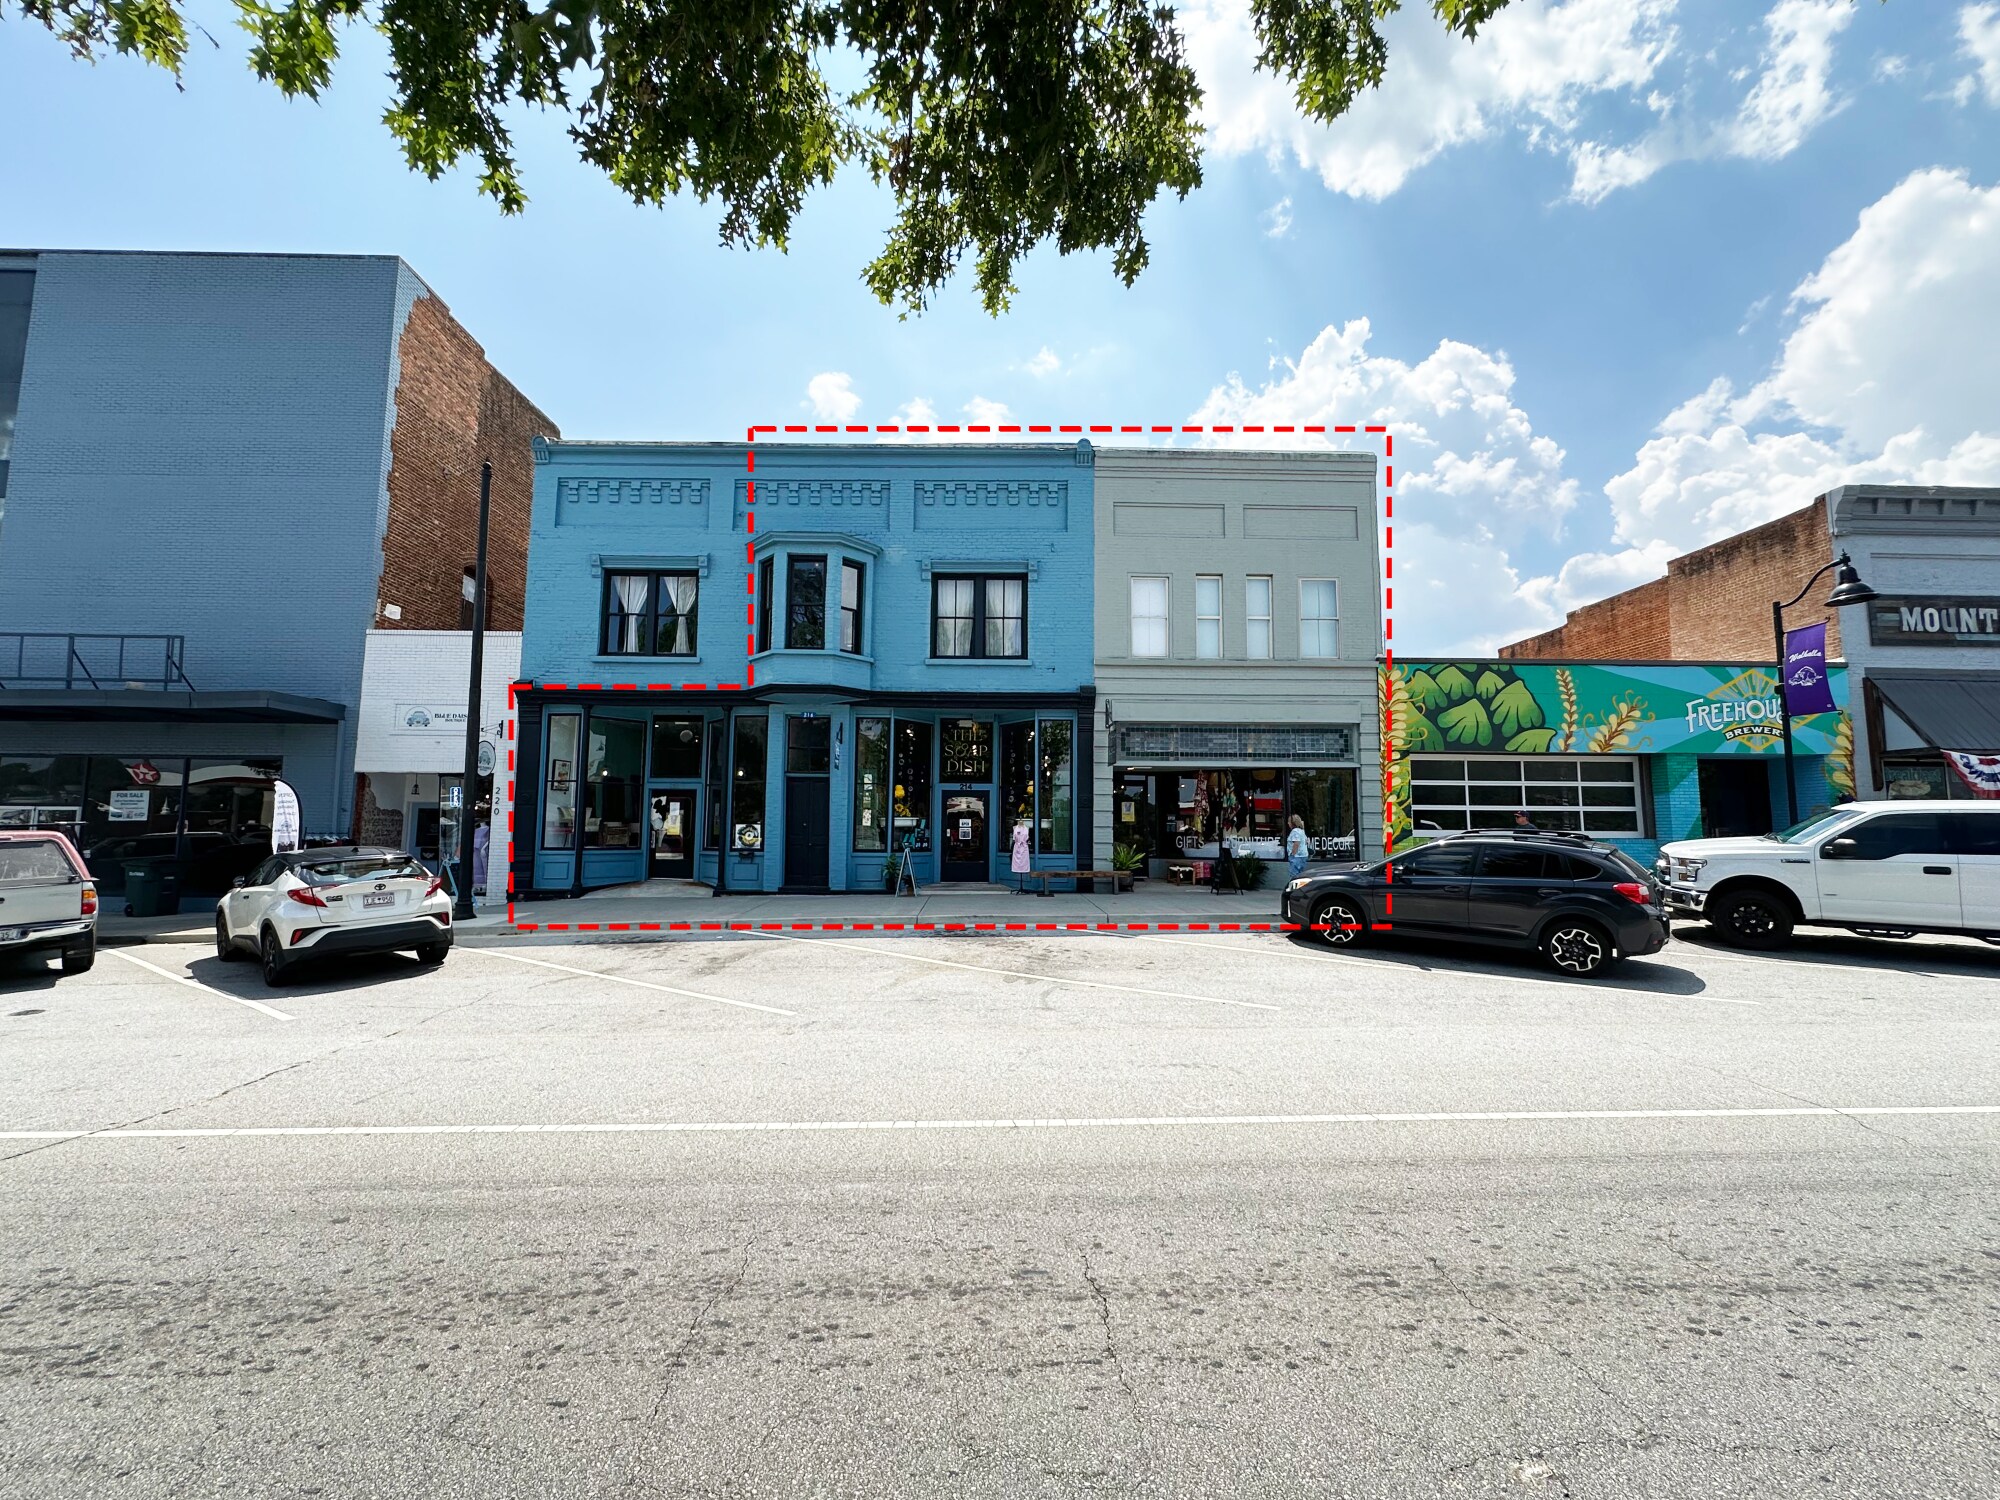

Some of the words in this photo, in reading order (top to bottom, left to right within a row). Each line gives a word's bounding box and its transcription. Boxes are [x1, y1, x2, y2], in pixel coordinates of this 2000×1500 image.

[1900, 606, 1998, 633] MOUNT
[1788, 649, 1822, 663] Walhalla
[1685, 698, 1783, 733] FREEHOU
[951, 729, 984, 741] THE
[1725, 726, 1784, 740] BREWER
[944, 743, 988, 757] SOAP
[947, 760, 985, 773] DISH
[1176, 835, 1204, 849] GIFTS
[1321, 837, 1351, 850] DECOR
